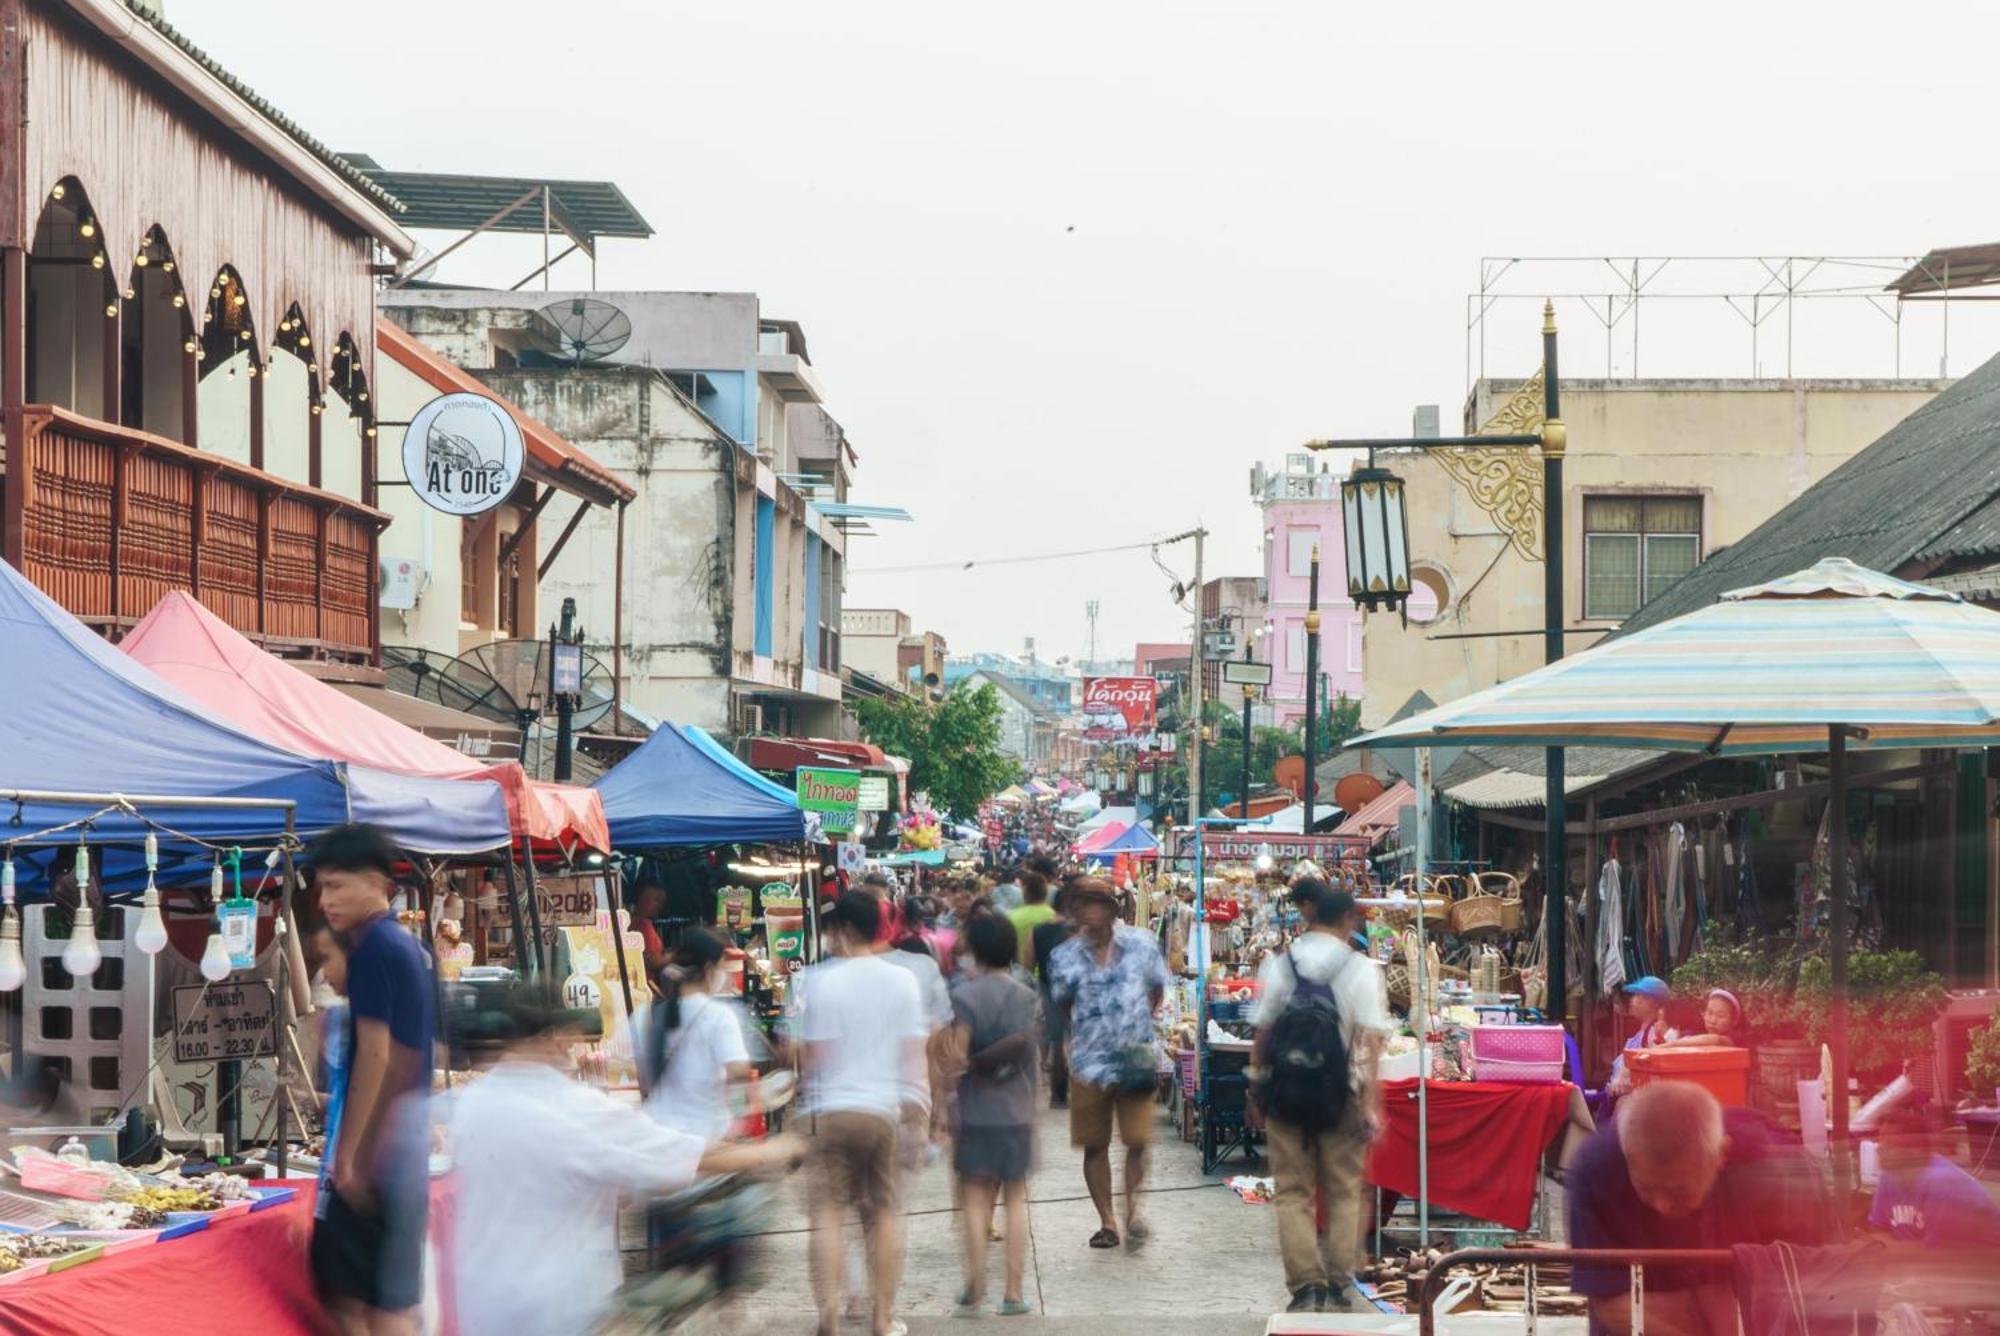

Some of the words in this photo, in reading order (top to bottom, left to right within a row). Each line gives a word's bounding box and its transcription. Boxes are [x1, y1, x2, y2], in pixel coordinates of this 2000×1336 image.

[427, 461, 451, 493] At
[461, 469, 501, 495] one
[804, 772, 858, 802] ไก่ทอด
[788, 960, 801, 970] 20
[181, 1042, 208, 1057] 16.00
[225, 1039, 255, 1054] 22.30
